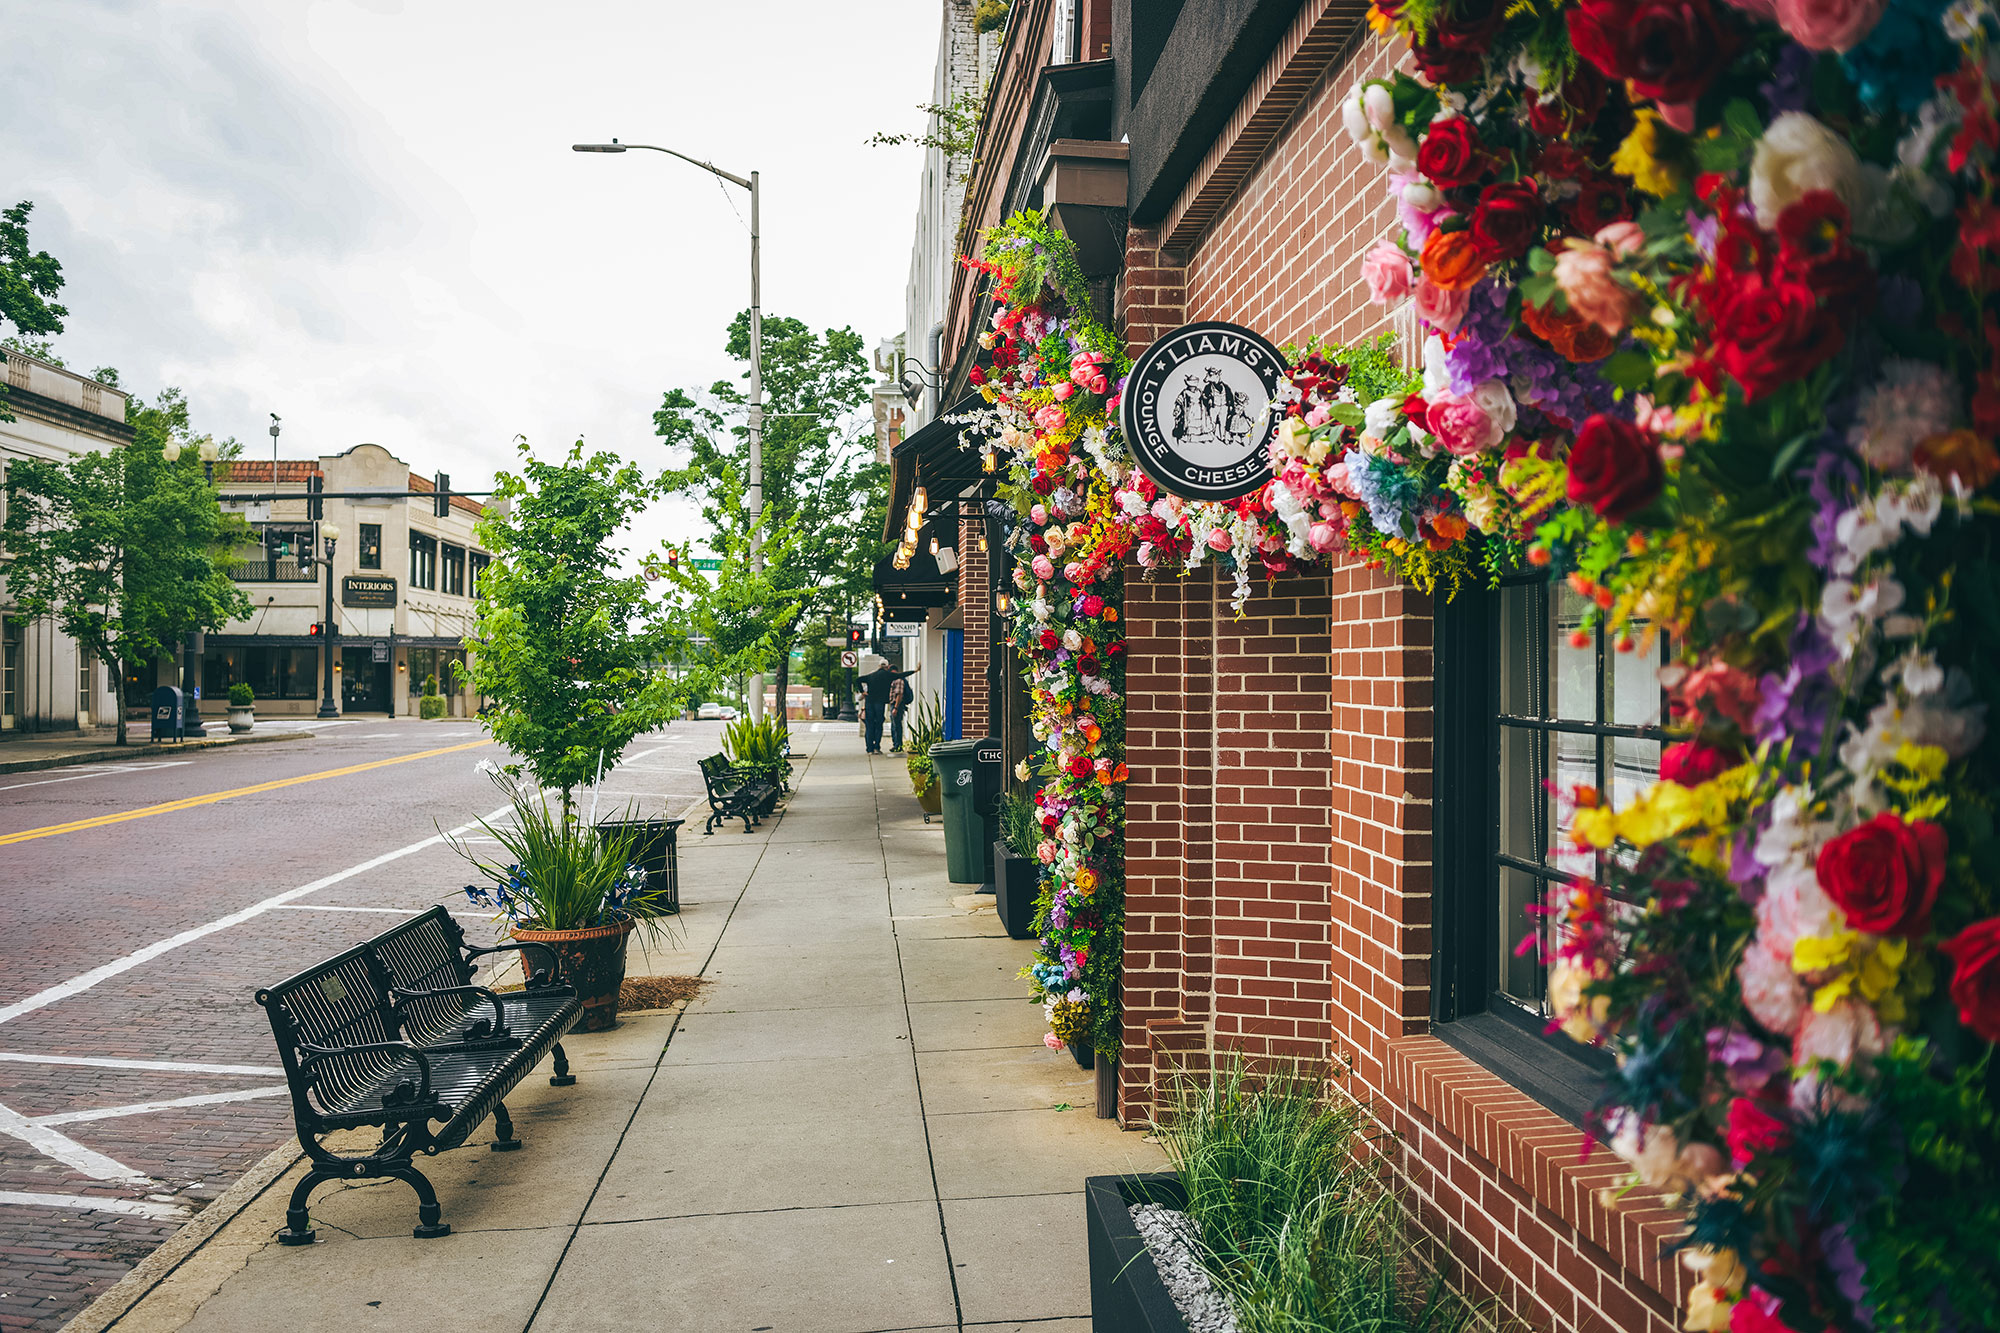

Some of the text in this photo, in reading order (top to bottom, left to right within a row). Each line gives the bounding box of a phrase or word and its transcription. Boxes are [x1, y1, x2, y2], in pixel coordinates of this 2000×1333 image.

[1167, 335, 1263, 367] LIAM'S
[1141, 379, 1169, 459] LOUNGE
[1184, 458, 1260, 484] CHEESE
[348, 580, 394, 591] INTERIORS
